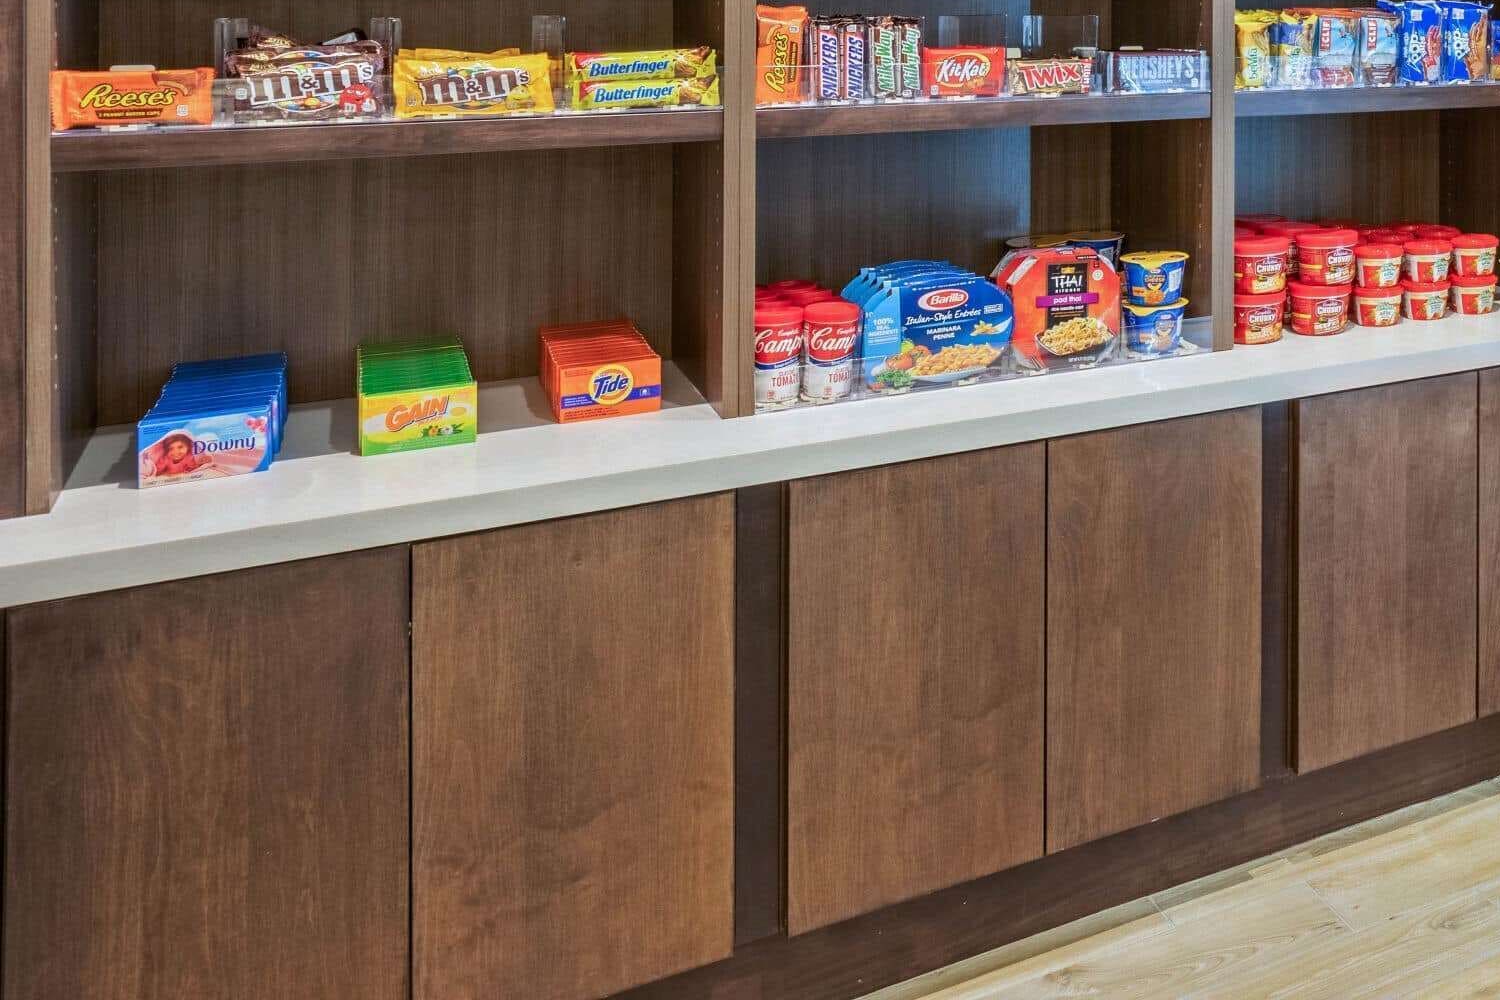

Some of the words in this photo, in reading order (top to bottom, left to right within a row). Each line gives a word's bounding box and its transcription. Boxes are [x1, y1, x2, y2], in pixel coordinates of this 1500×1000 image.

[589, 60, 670, 78] Butterfinger
[764, 33, 790, 93] Reese's
[821, 34, 838, 100] SNICKERS
[847, 36, 864, 100] SNICKERS
[80, 83, 177, 109] Reese's
[594, 85, 675, 103] Butterfinger
[1051, 274, 1083, 290] THAI
[930, 292, 964, 306] Barilla
[1053, 296, 1068, 305] pad
[1069, 294, 1082, 303] thai
[926, 324, 962, 336] MARINARA
[932, 333, 956, 341] PENNE
[593, 374, 629, 400] Tide
[385, 394, 449, 432] GAIN
[192, 436, 256, 455] Downy
